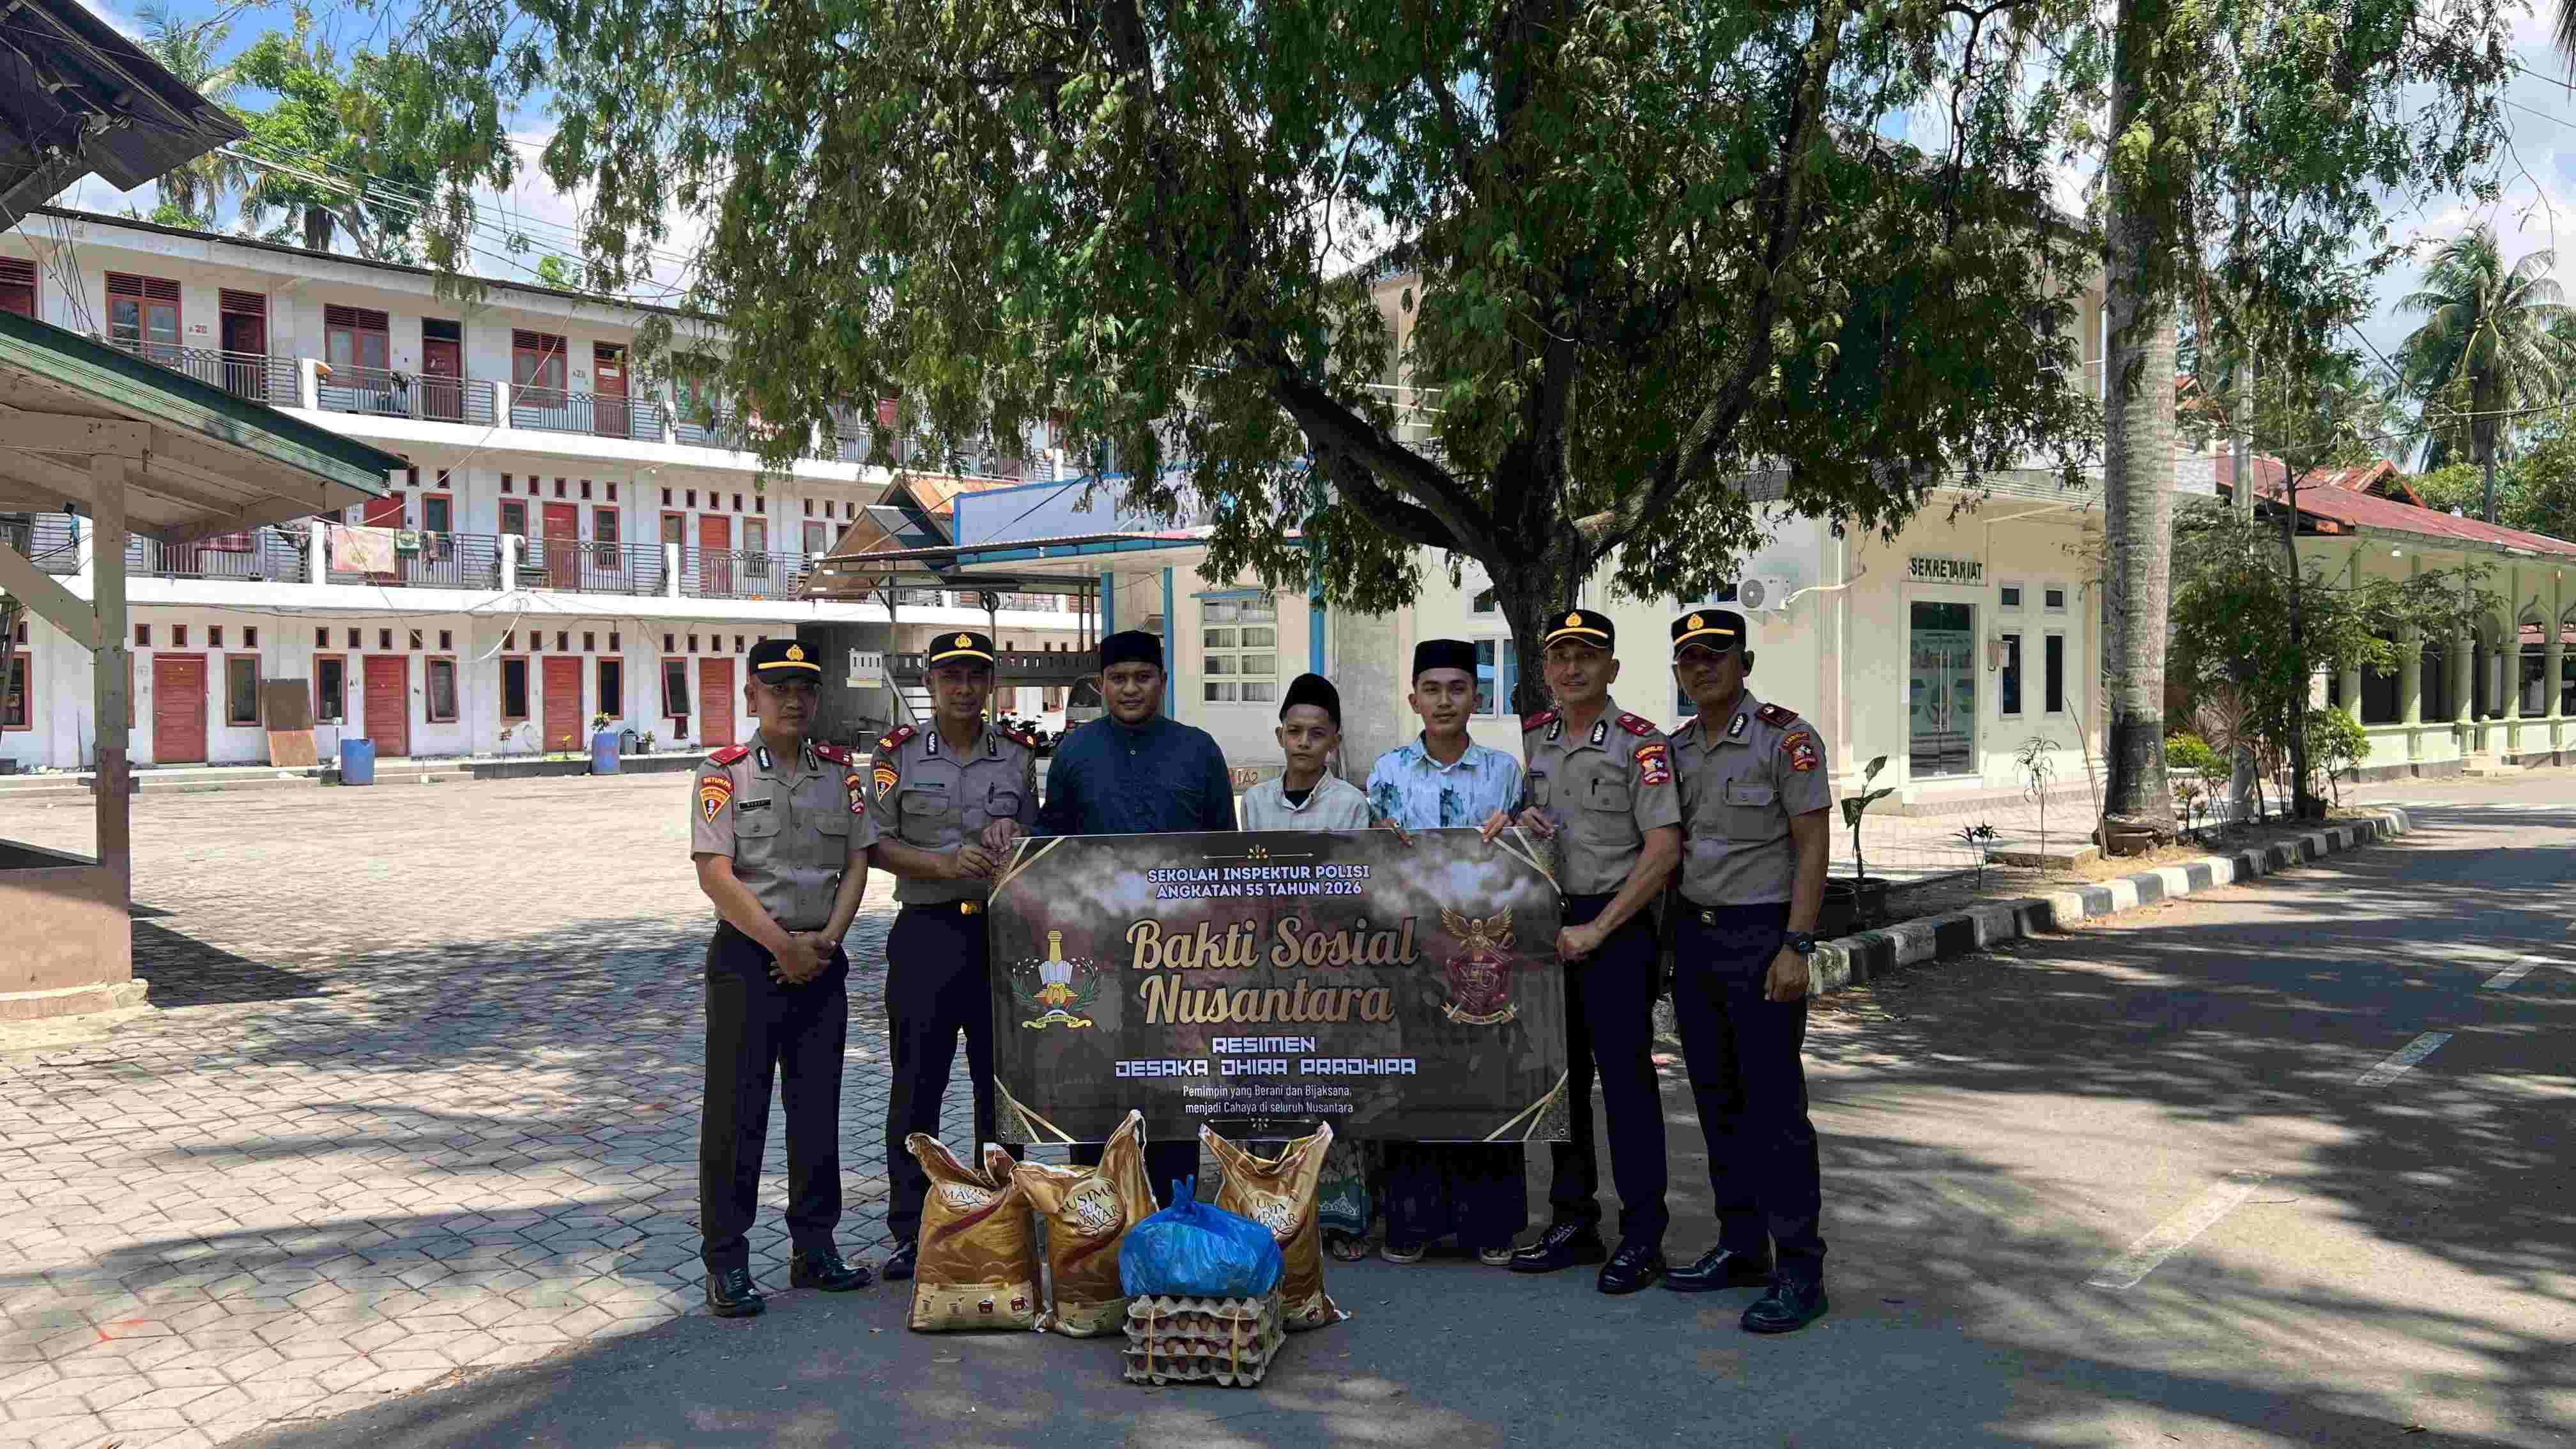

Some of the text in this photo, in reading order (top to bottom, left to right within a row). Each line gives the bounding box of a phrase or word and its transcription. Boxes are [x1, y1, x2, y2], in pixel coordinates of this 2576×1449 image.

[1911, 556, 1983, 579] SEKRETARIAT
[1148, 864, 1370, 883] SEKOLAH INSPEKTUR POLISI
[1156, 881, 1361, 898] ANGKATAN 55 TAHUN 2026
[1126, 916, 1420, 969] Bakti Sosial
[1140, 973, 1396, 1023] Nusantara
[1212, 1036, 1315, 1054] RESIMEN
[1115, 1058, 1416, 1077] DESAKA DHIRA PRADHIPA
[1183, 1085, 1352, 1099] Pemimpin yang Berani dan Bijaksana,
[1185, 1101, 1353, 1116] menjadi Cahaya di seluruh Nusantara
